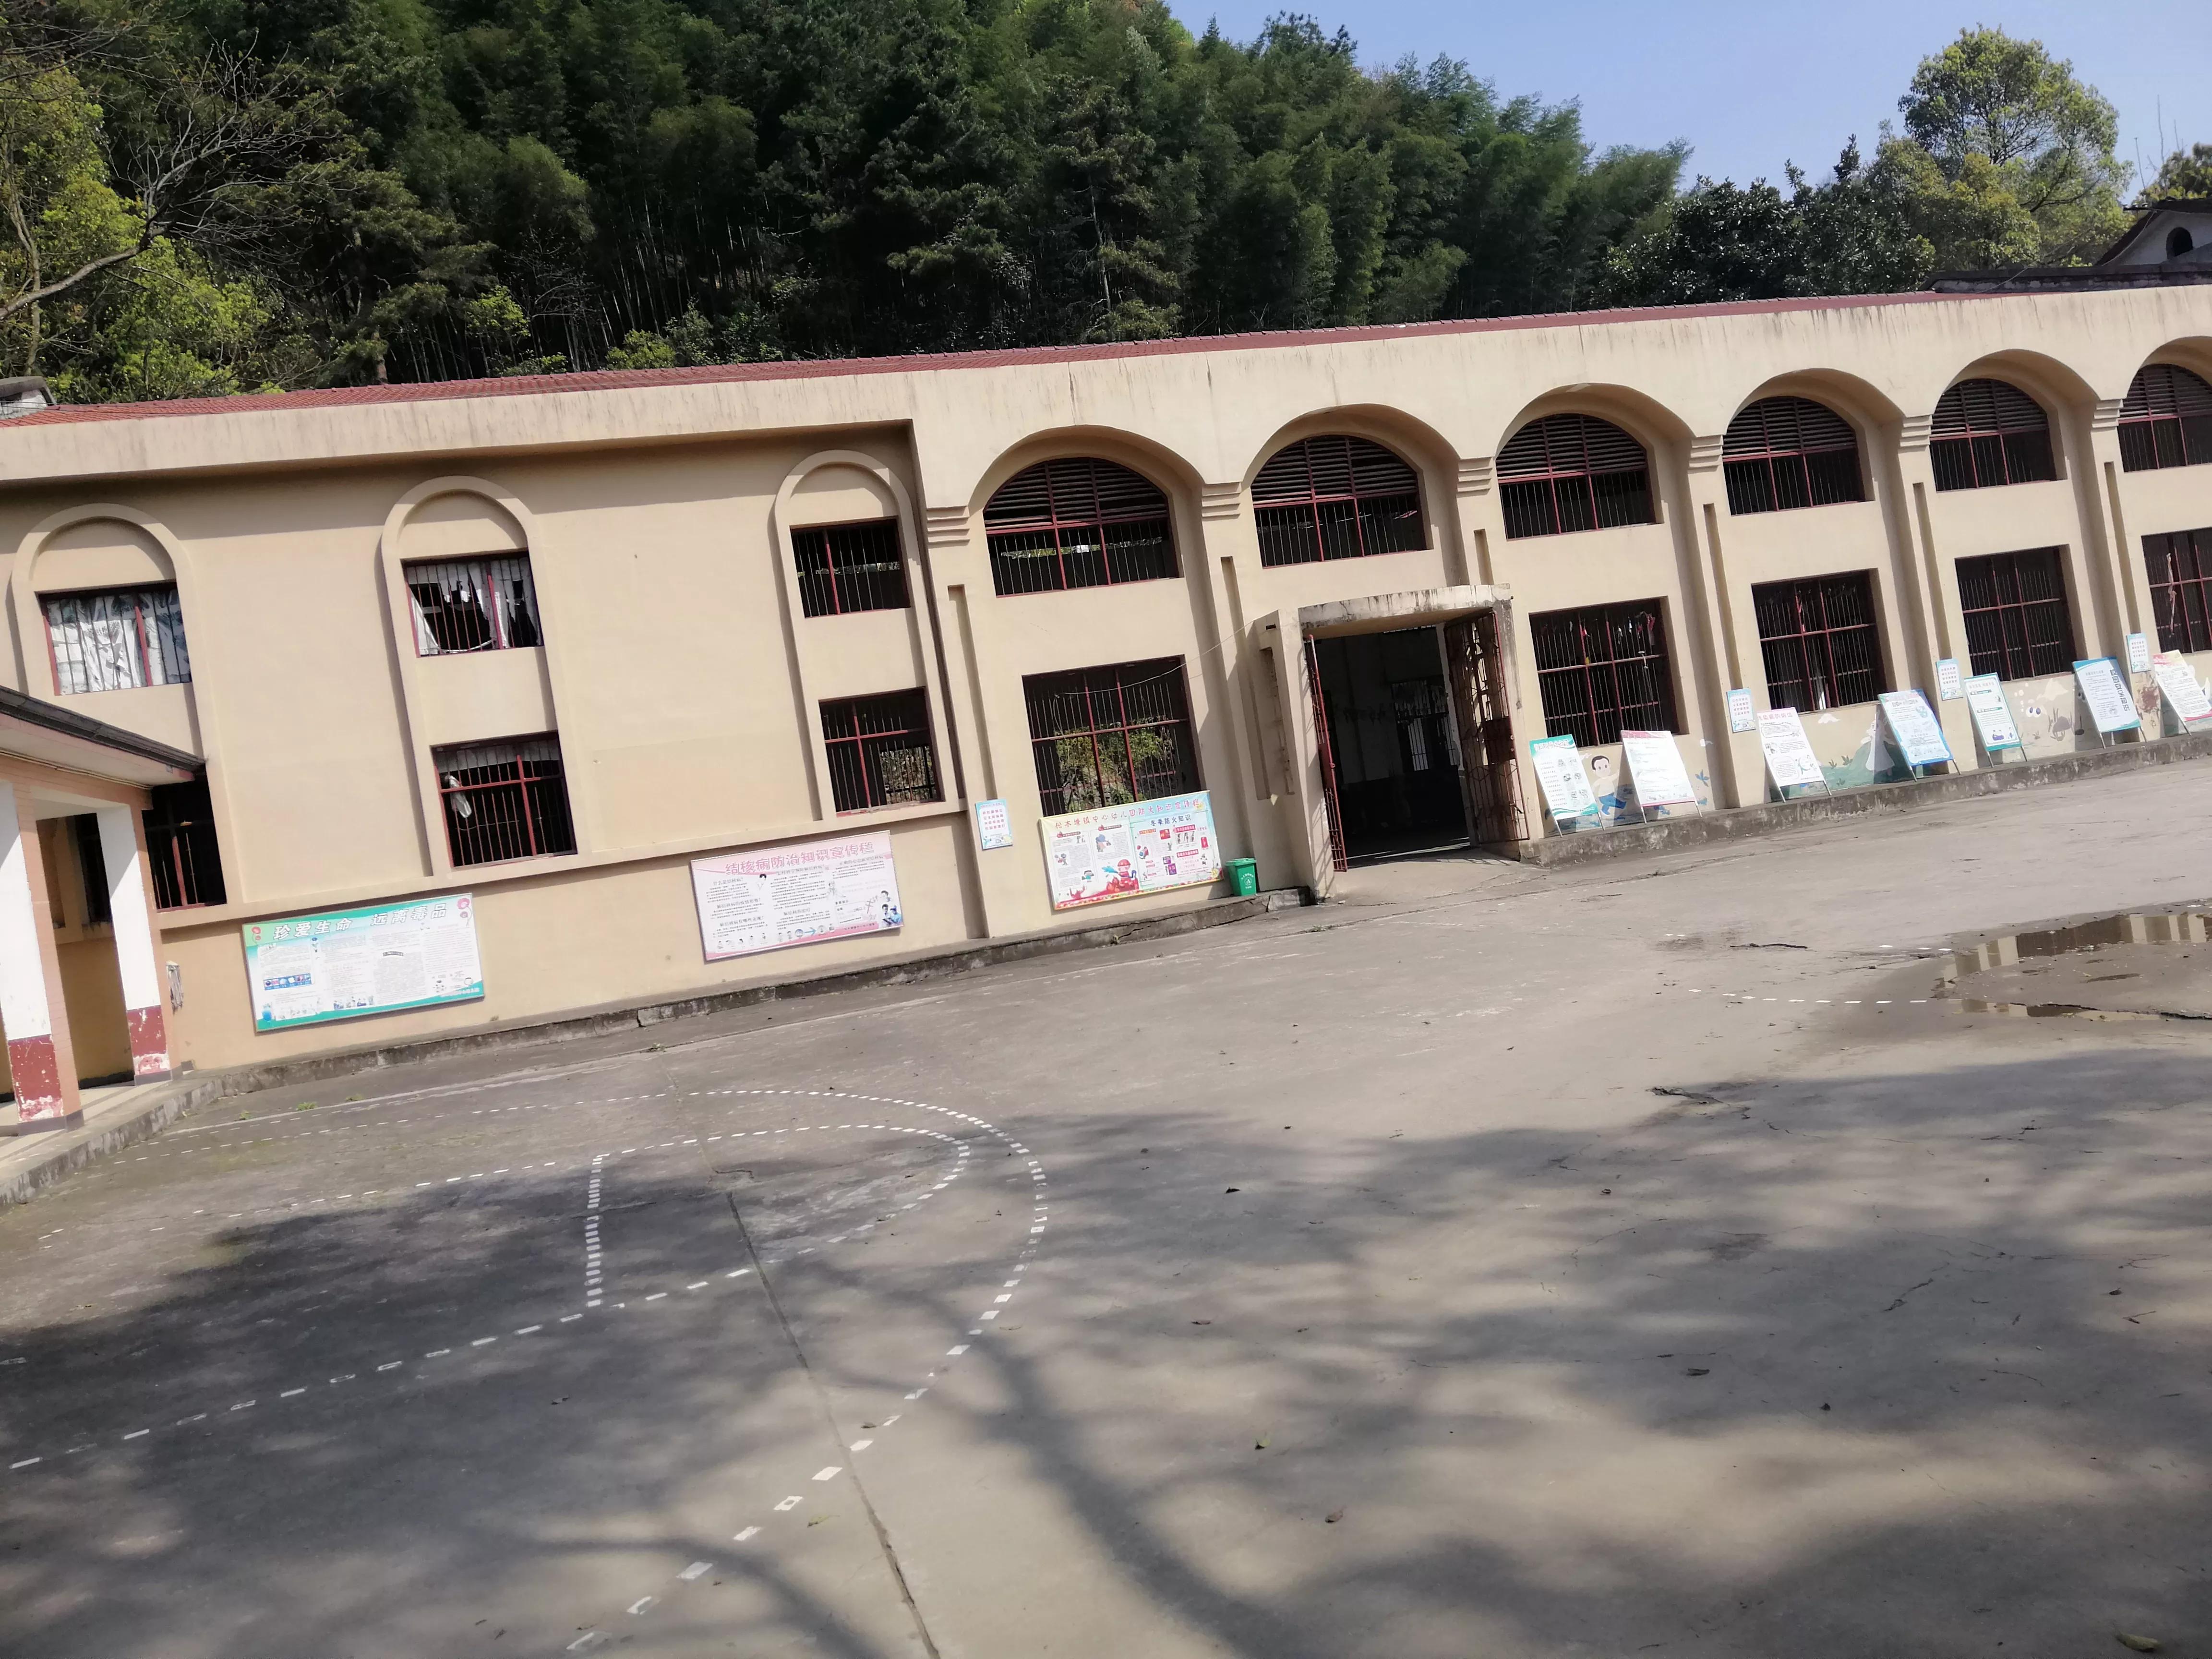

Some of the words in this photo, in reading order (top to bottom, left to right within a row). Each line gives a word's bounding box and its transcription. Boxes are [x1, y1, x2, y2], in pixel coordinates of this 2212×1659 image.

[1151, 814, 1191, 827] 冬季防火知识
[725, 841, 874, 875] 结核病防治知识宣传栏
[273, 917, 353, 940] 珍爱生命
[371, 902, 448, 927] 远离毒品
